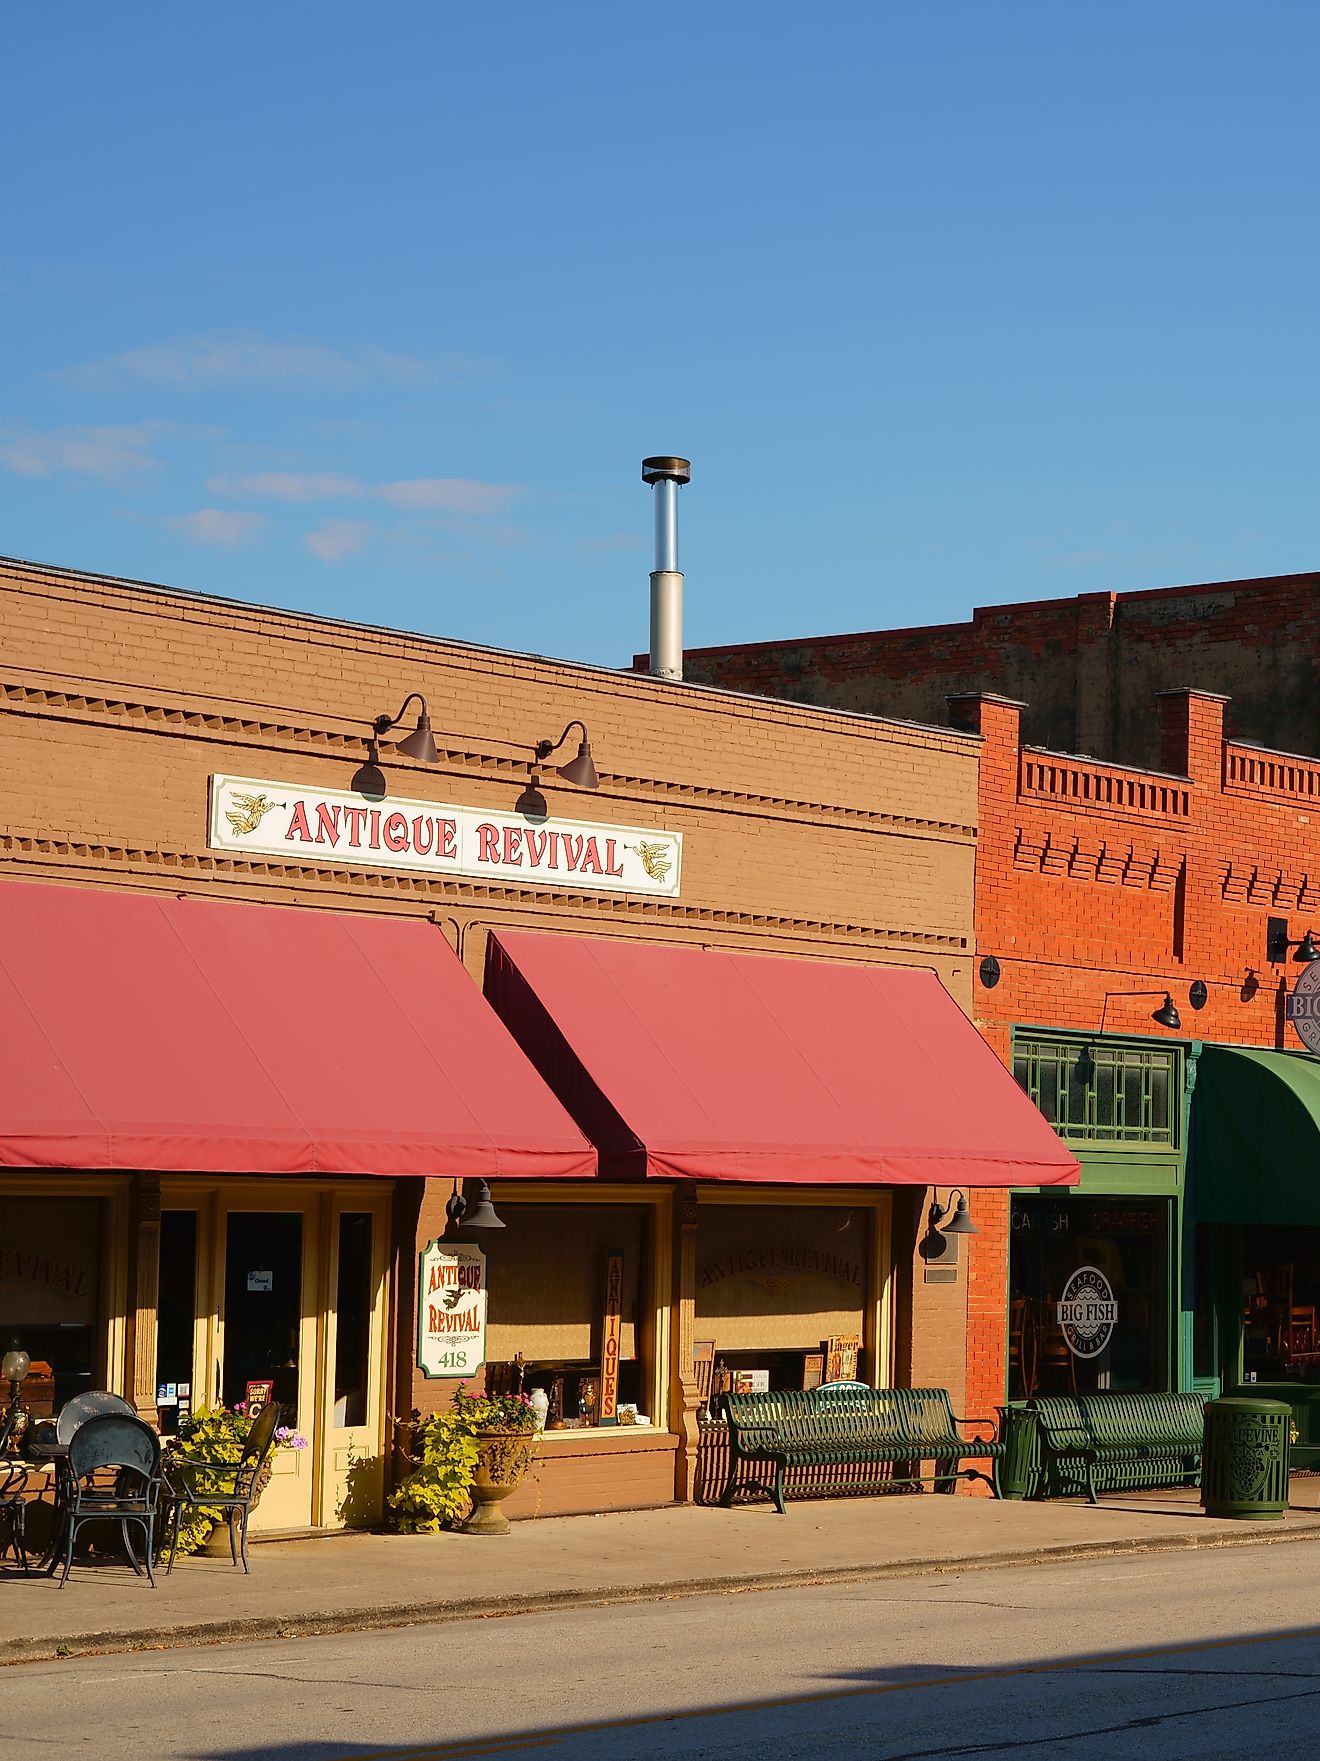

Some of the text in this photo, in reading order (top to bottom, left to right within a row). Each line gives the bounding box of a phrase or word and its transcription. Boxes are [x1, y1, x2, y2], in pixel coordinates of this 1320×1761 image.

[285, 800, 625, 878] ANTIQUE REVIVAL
[1011, 1211, 1069, 1231] CATFSH
[428, 1265, 481, 1295] ANTIQUE
[702, 1246, 862, 1288] ANTIQUE REVIVAL
[1067, 1273, 1108, 1300] SEAFOOD
[429, 1304, 480, 1333] REVIVAL
[1061, 1303, 1114, 1321] BIG FISH
[603, 1258, 622, 1416] ANTIQUES
[829, 1337, 860, 1352] Lager
[1067, 1326, 1087, 1351] GRILL
[1096, 1325, 1109, 1346] BAR
[438, 1351, 467, 1368] 418
[250, 1387, 267, 1395] SORRY
[1217, 1428, 1279, 1442] RAPEVINE
